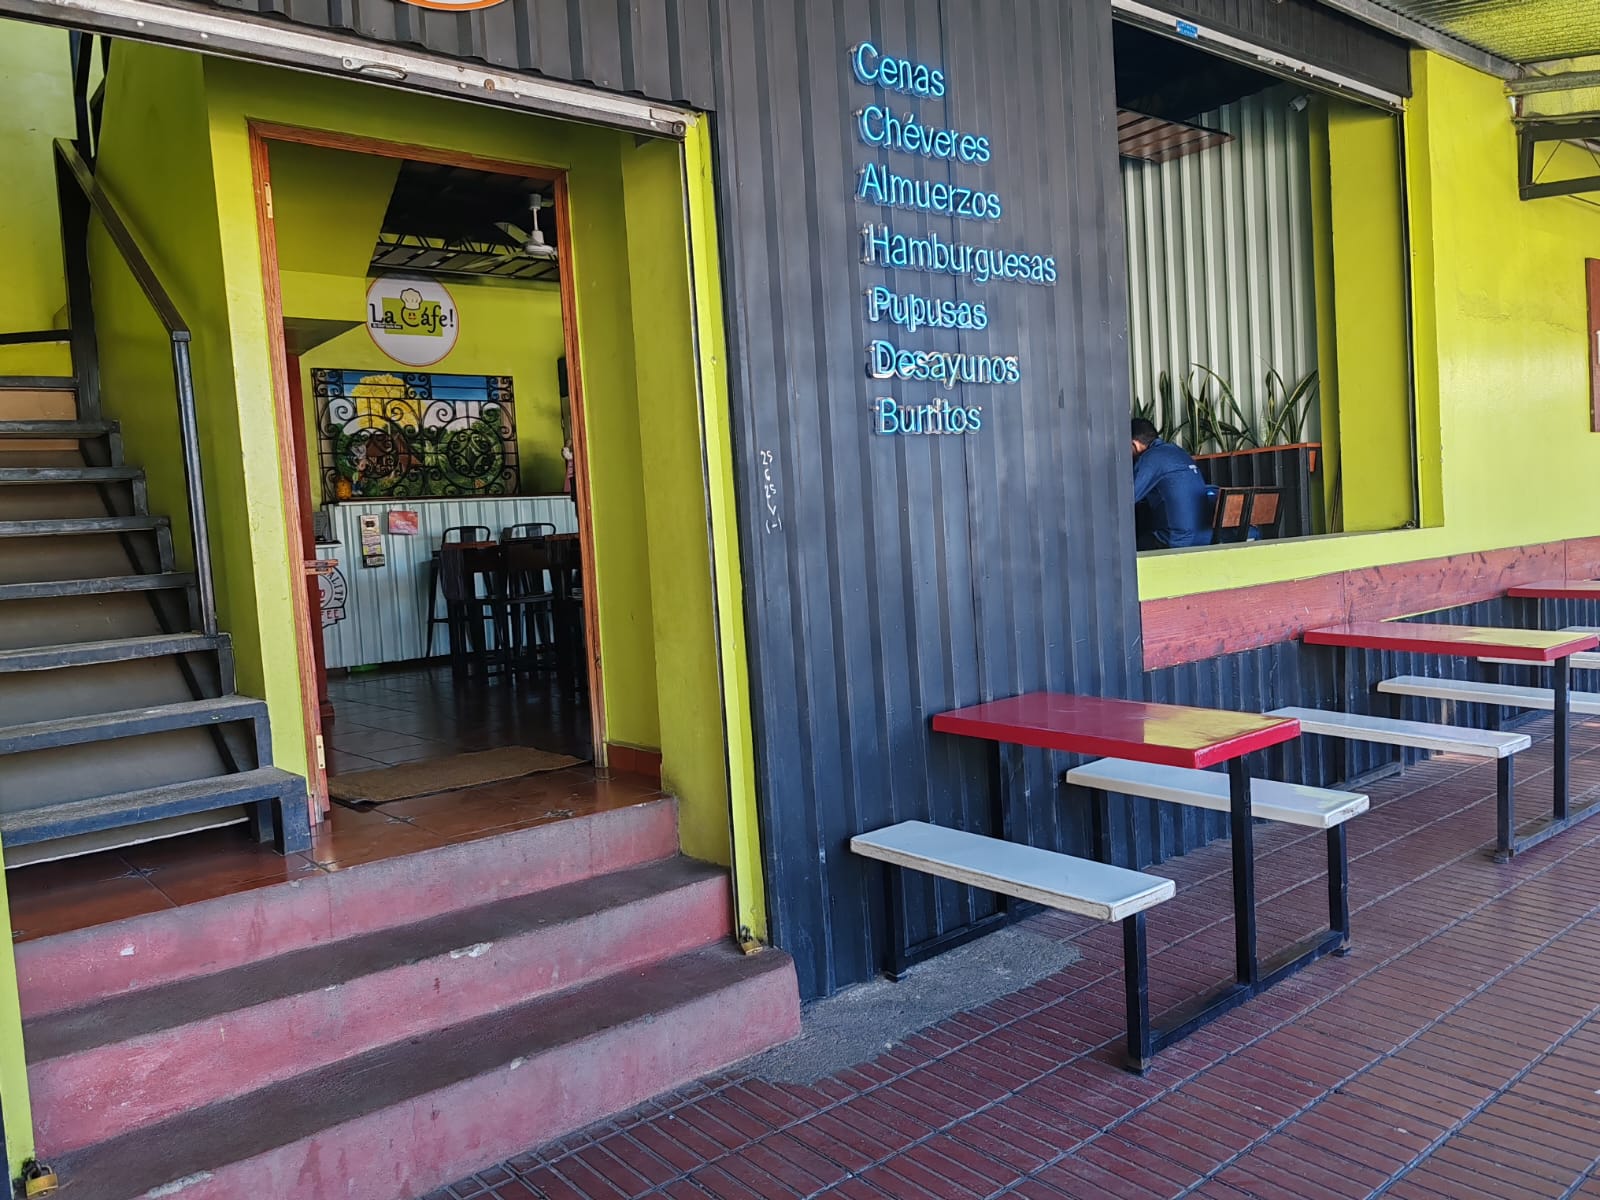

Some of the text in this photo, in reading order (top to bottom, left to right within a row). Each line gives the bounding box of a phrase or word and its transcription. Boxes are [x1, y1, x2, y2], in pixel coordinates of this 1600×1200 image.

[853, 41, 945, 98] Cenas
[858, 104, 991, 164] Chéveres
[858, 162, 1002, 220] Almuerzos
[864, 223, 1057, 285] Hamburguesas
[369, 303, 396, 323] La
[868, 286, 988, 332] Pupusas
[871, 340, 1020, 389] Desayunos
[875, 398, 981, 434] Burritos
